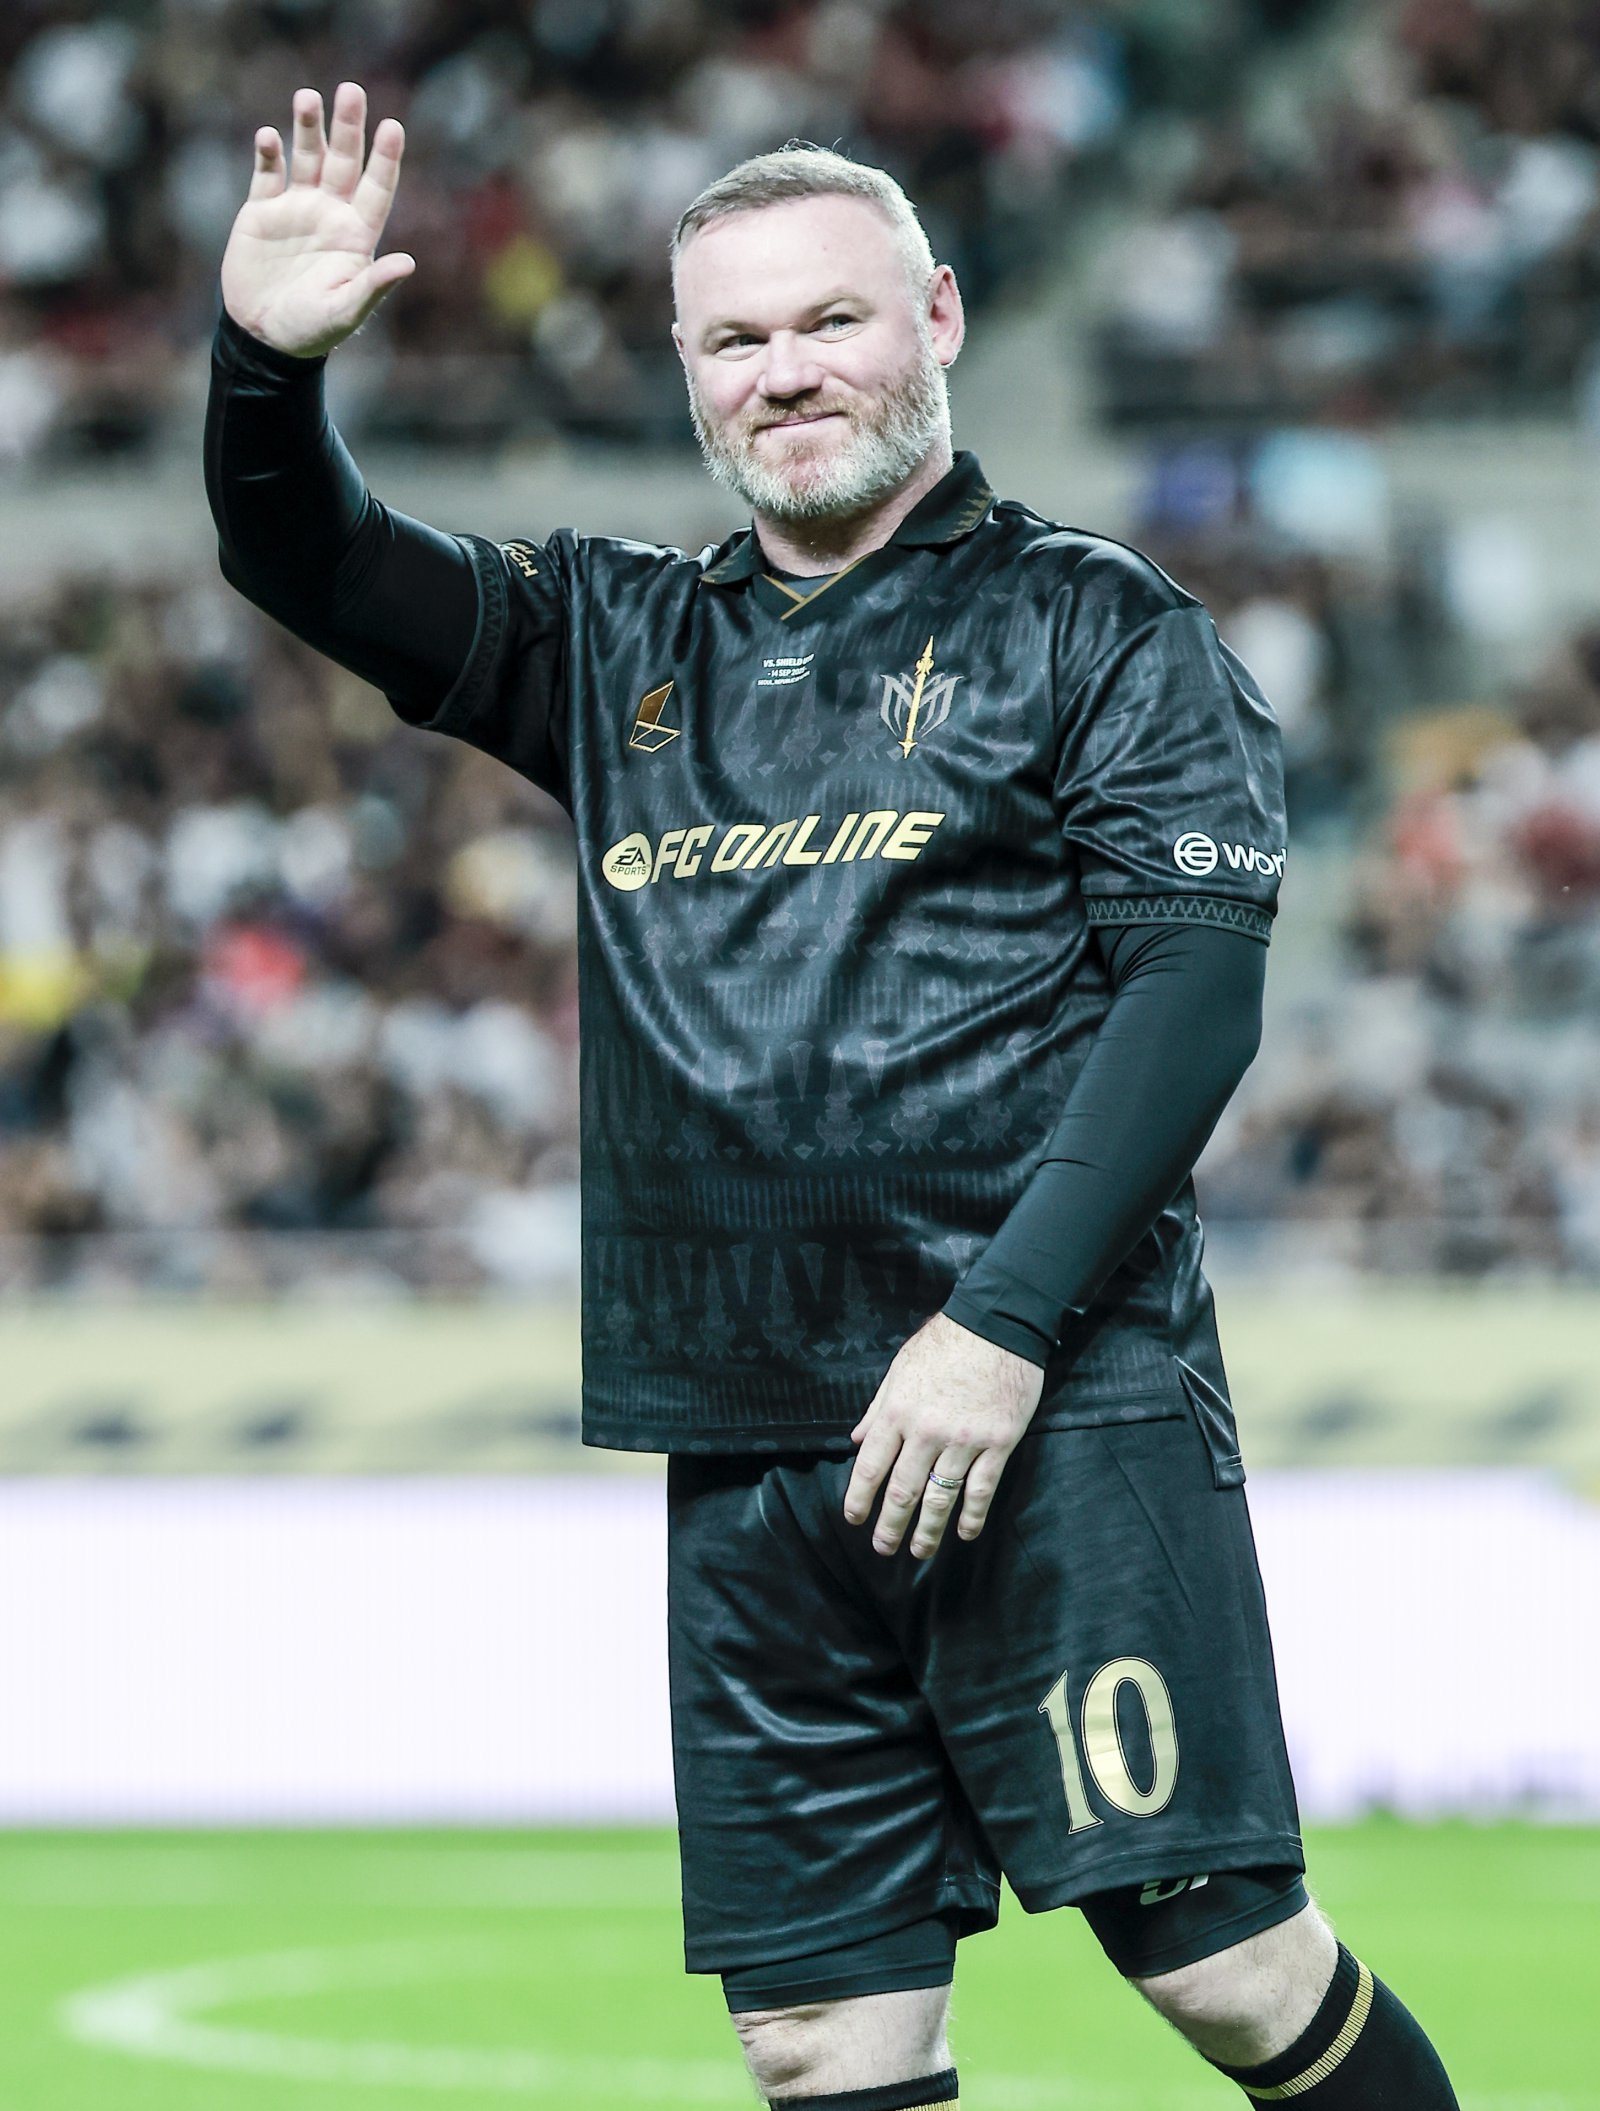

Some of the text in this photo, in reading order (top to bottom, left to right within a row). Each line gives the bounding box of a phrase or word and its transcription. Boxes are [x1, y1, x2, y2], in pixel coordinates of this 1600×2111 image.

[776, 657, 803, 667] SHIELD
[614, 846, 646, 866] EA
[651, 810, 946, 884] FC ONLINE
[610, 864, 647, 876] SPORTS
[1037, 1656, 1180, 1835] 10
